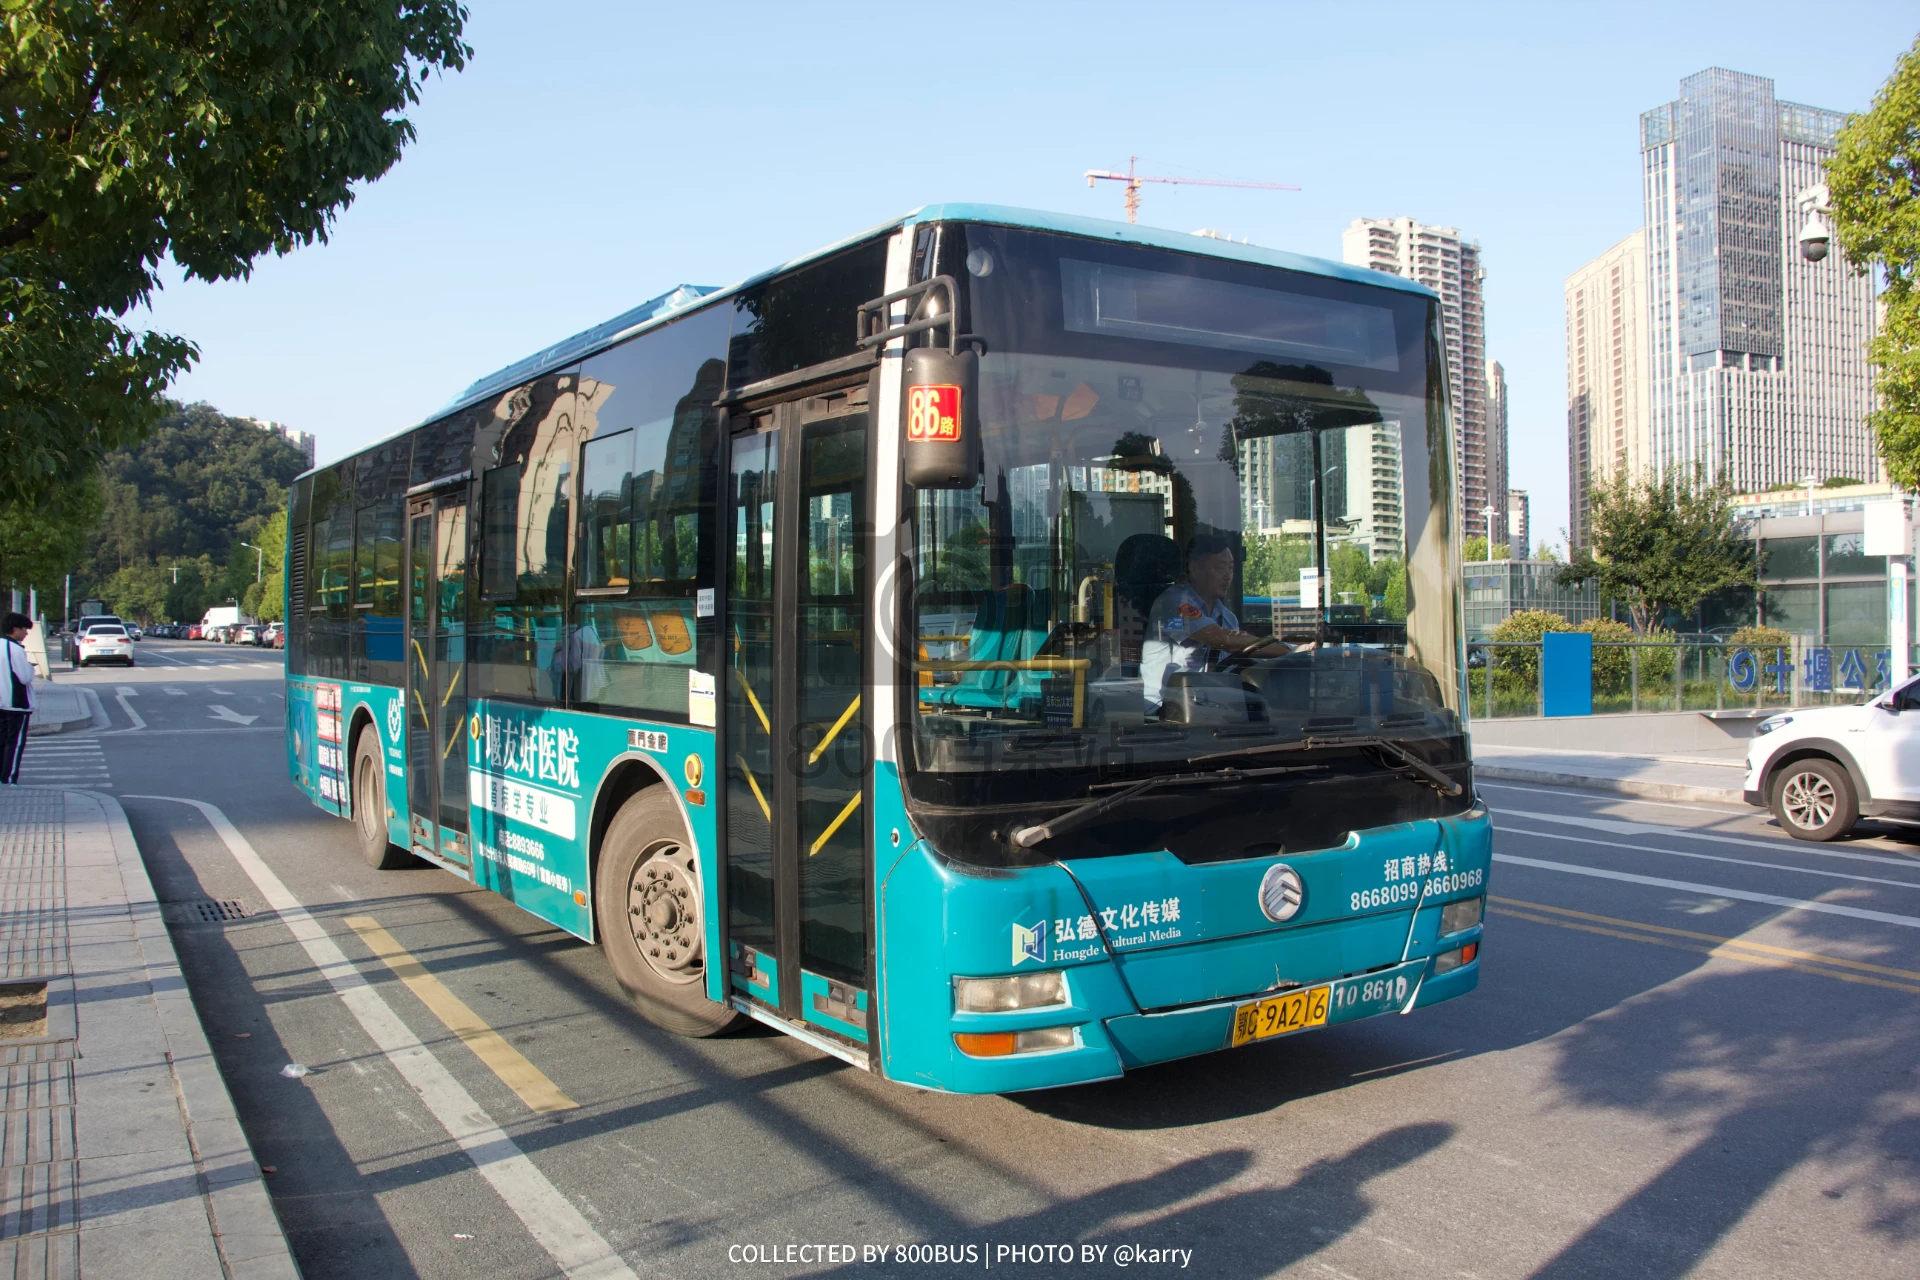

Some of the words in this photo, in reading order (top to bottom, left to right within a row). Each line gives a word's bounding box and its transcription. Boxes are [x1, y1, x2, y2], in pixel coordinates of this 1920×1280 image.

[910, 390, 955, 436] 86路
[1350, 881, 1418, 911] 8668099
[1424, 868, 1483, 897] 8660968
[1054, 896, 1181, 944] 弘德文化传媒
[1053, 944, 1100, 962] Hongde
[1149, 927, 1182, 943] Media
